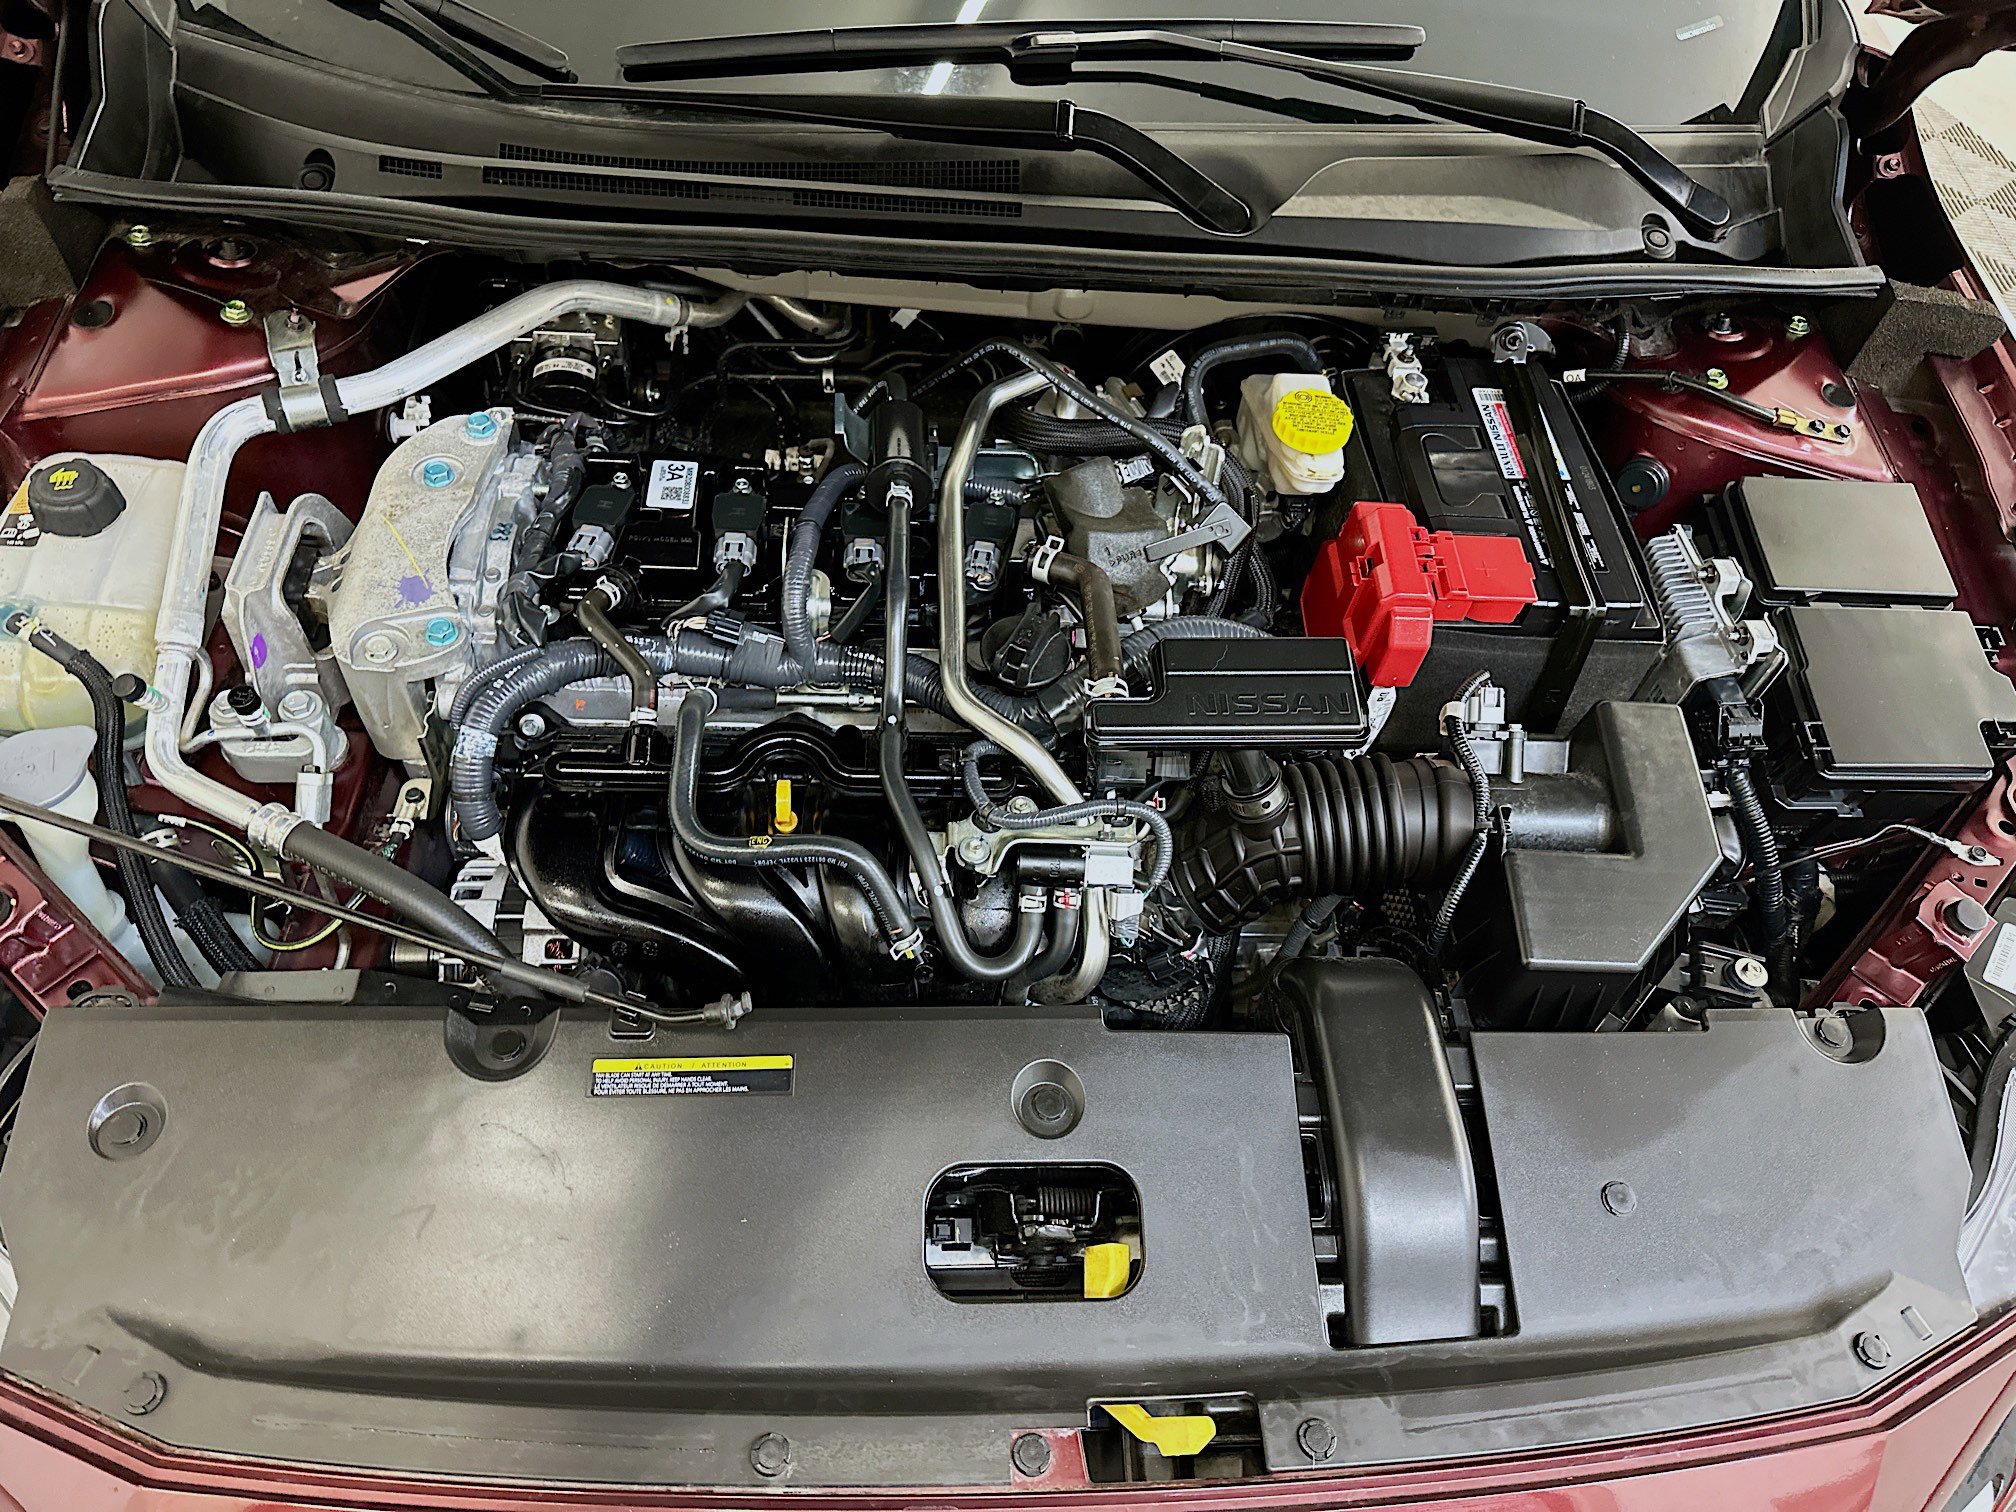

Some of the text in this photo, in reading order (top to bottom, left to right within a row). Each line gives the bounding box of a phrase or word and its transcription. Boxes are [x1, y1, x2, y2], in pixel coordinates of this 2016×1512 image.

[1481, 404, 1501, 441] NISSAN
[1166, 453, 1177, 463] NOT
[666, 464, 685, 481] 3A
[1189, 692, 1352, 716] NISSAN
[701, 1061, 747, 1069] ATTENTION
